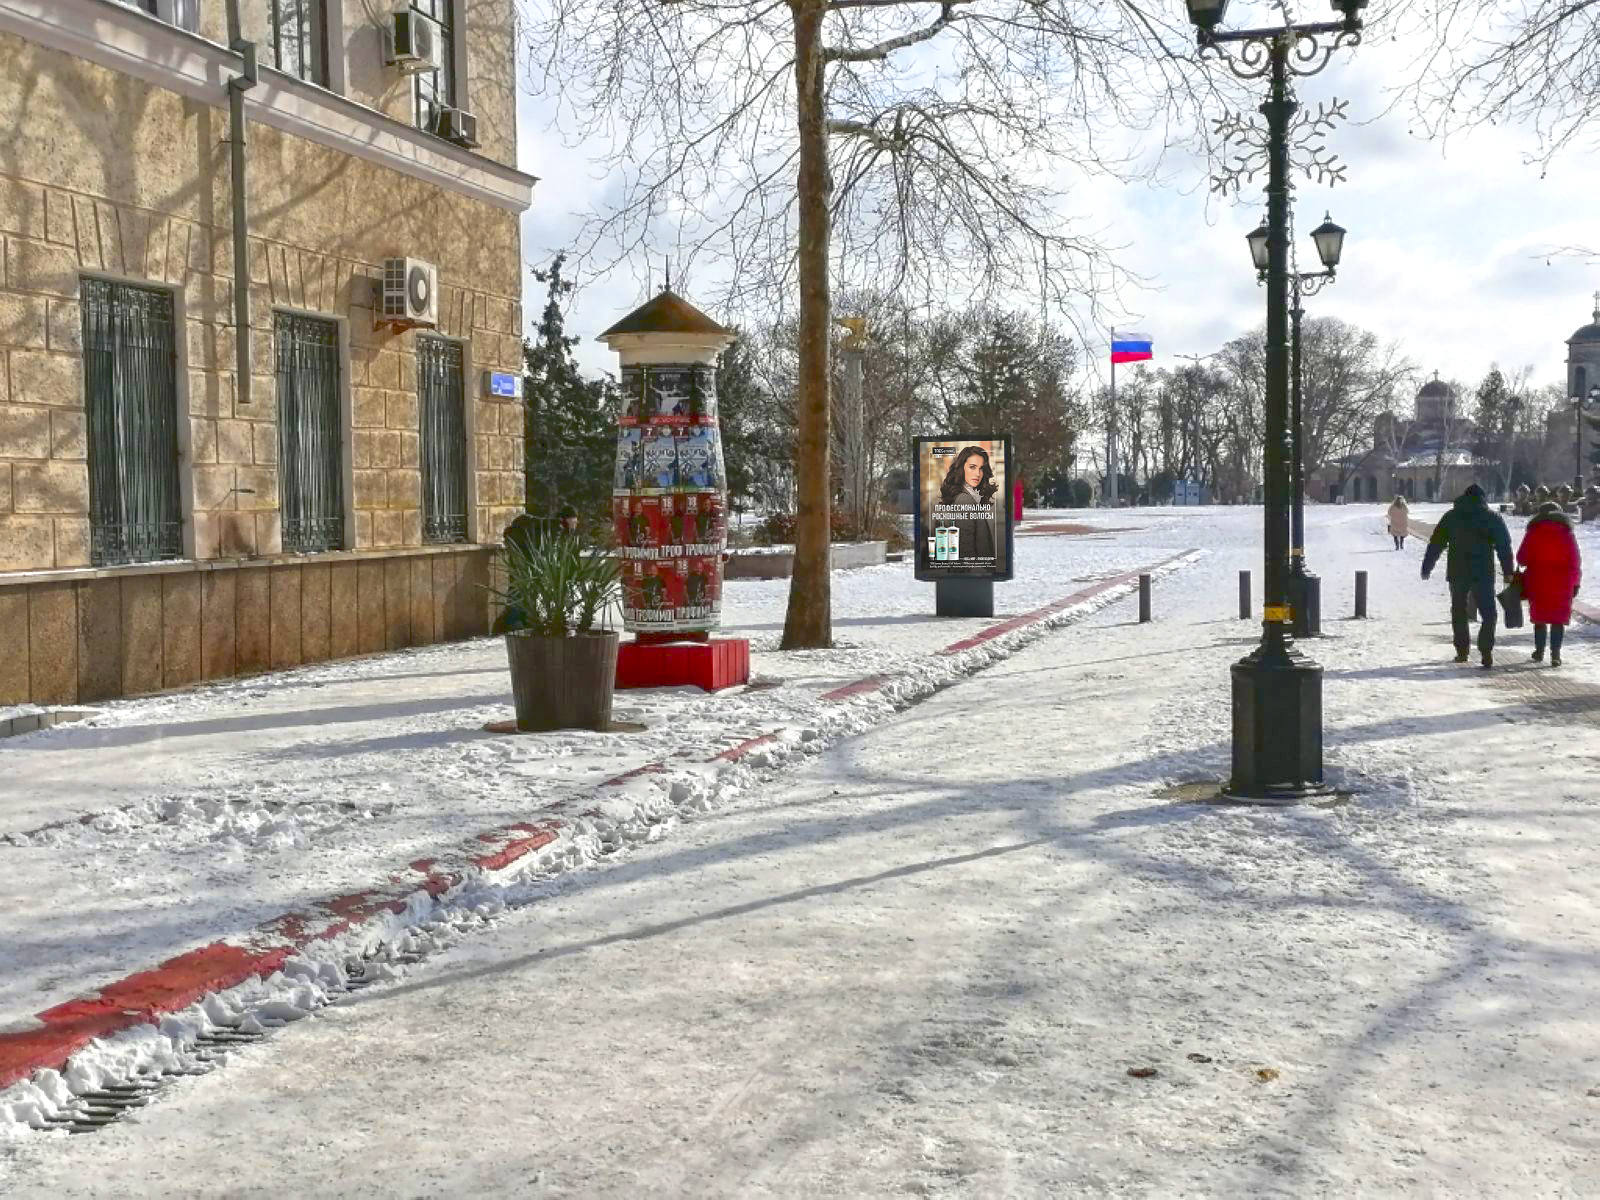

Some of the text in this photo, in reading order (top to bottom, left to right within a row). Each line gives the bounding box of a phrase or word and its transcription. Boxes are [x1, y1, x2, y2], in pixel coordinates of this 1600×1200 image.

[934, 504, 991, 512] ПРОФЕССИОНАЛЬНО
[931, 512, 994, 521] РОСКОШНЫЕ ВОЛОСЫ
